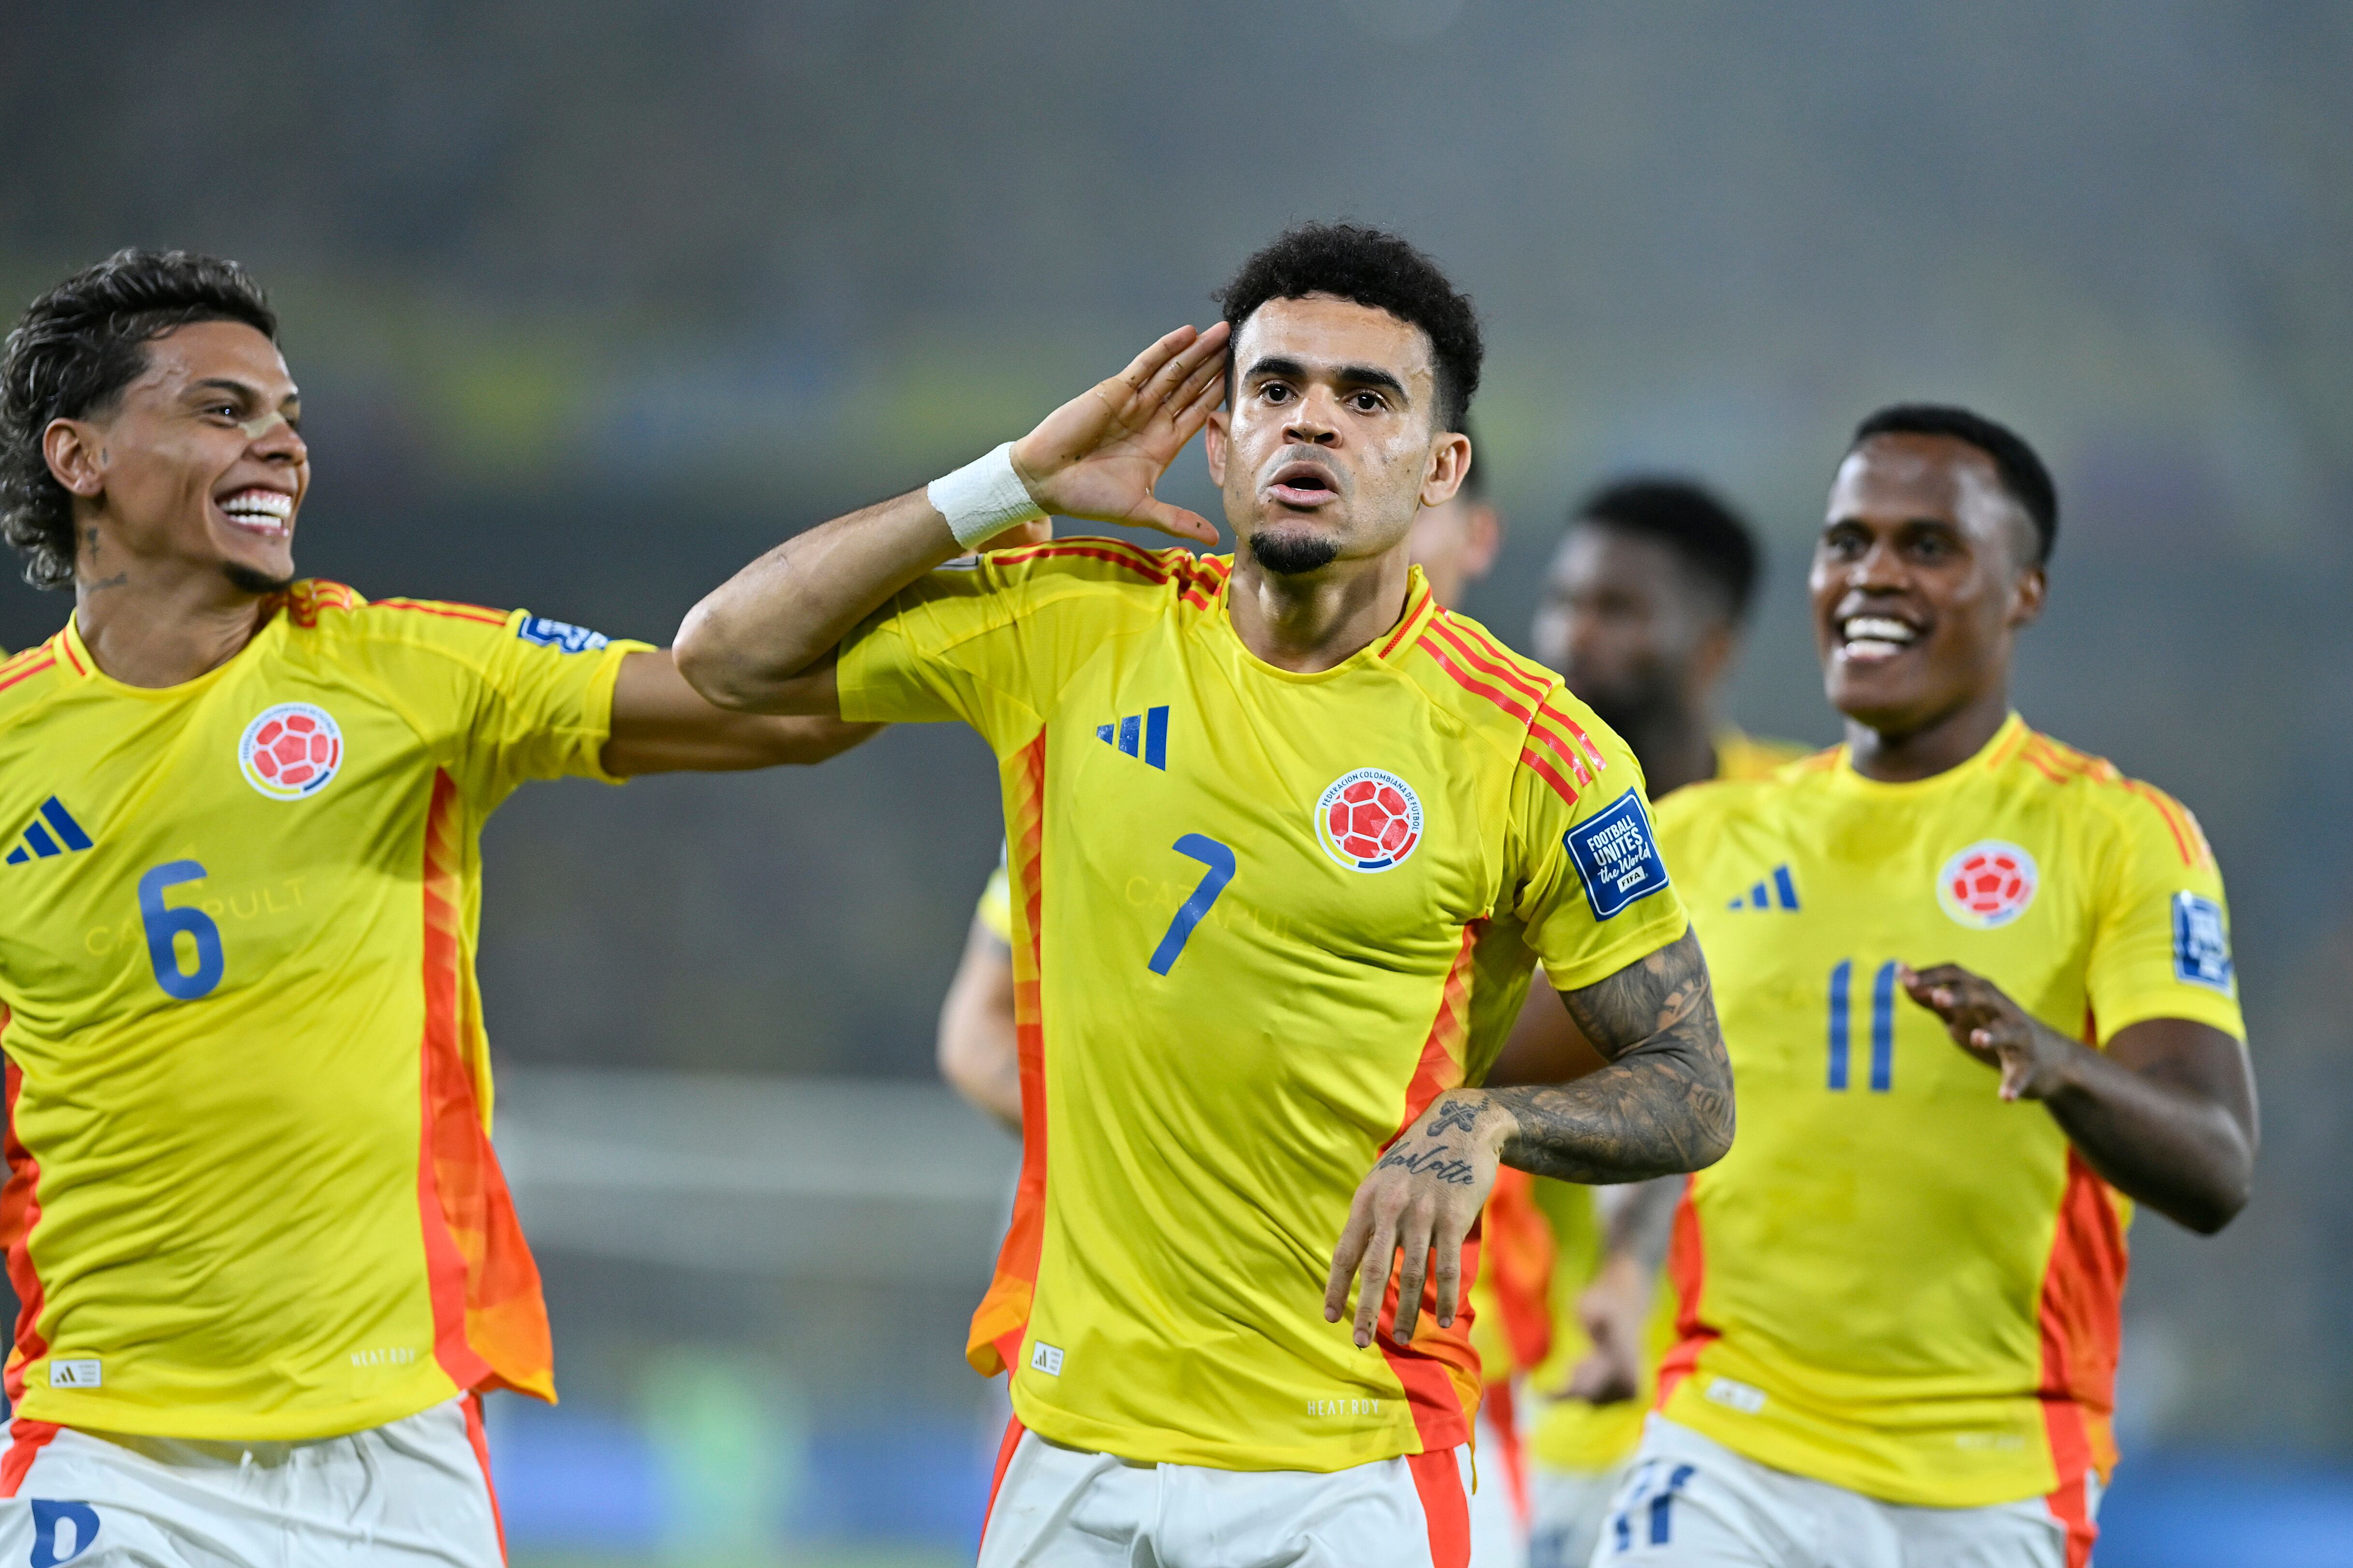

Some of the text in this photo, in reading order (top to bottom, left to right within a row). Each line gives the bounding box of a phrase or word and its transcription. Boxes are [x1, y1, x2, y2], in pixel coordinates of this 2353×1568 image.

[1322, 773, 1358, 806] FEDERACION
[1359, 771, 1407, 793] COLOMBIANA
[1405, 792, 1414, 801] DE
[1587, 814, 1636, 852] FOOTBALL
[1593, 827, 1644, 866] UNITES
[1597, 841, 1651, 884] the World
[1621, 872, 1641, 887] FIFA
[1147, 833, 1236, 976] 7
[138, 859, 225, 1000] 6
[1827, 956, 1897, 1092] 11
